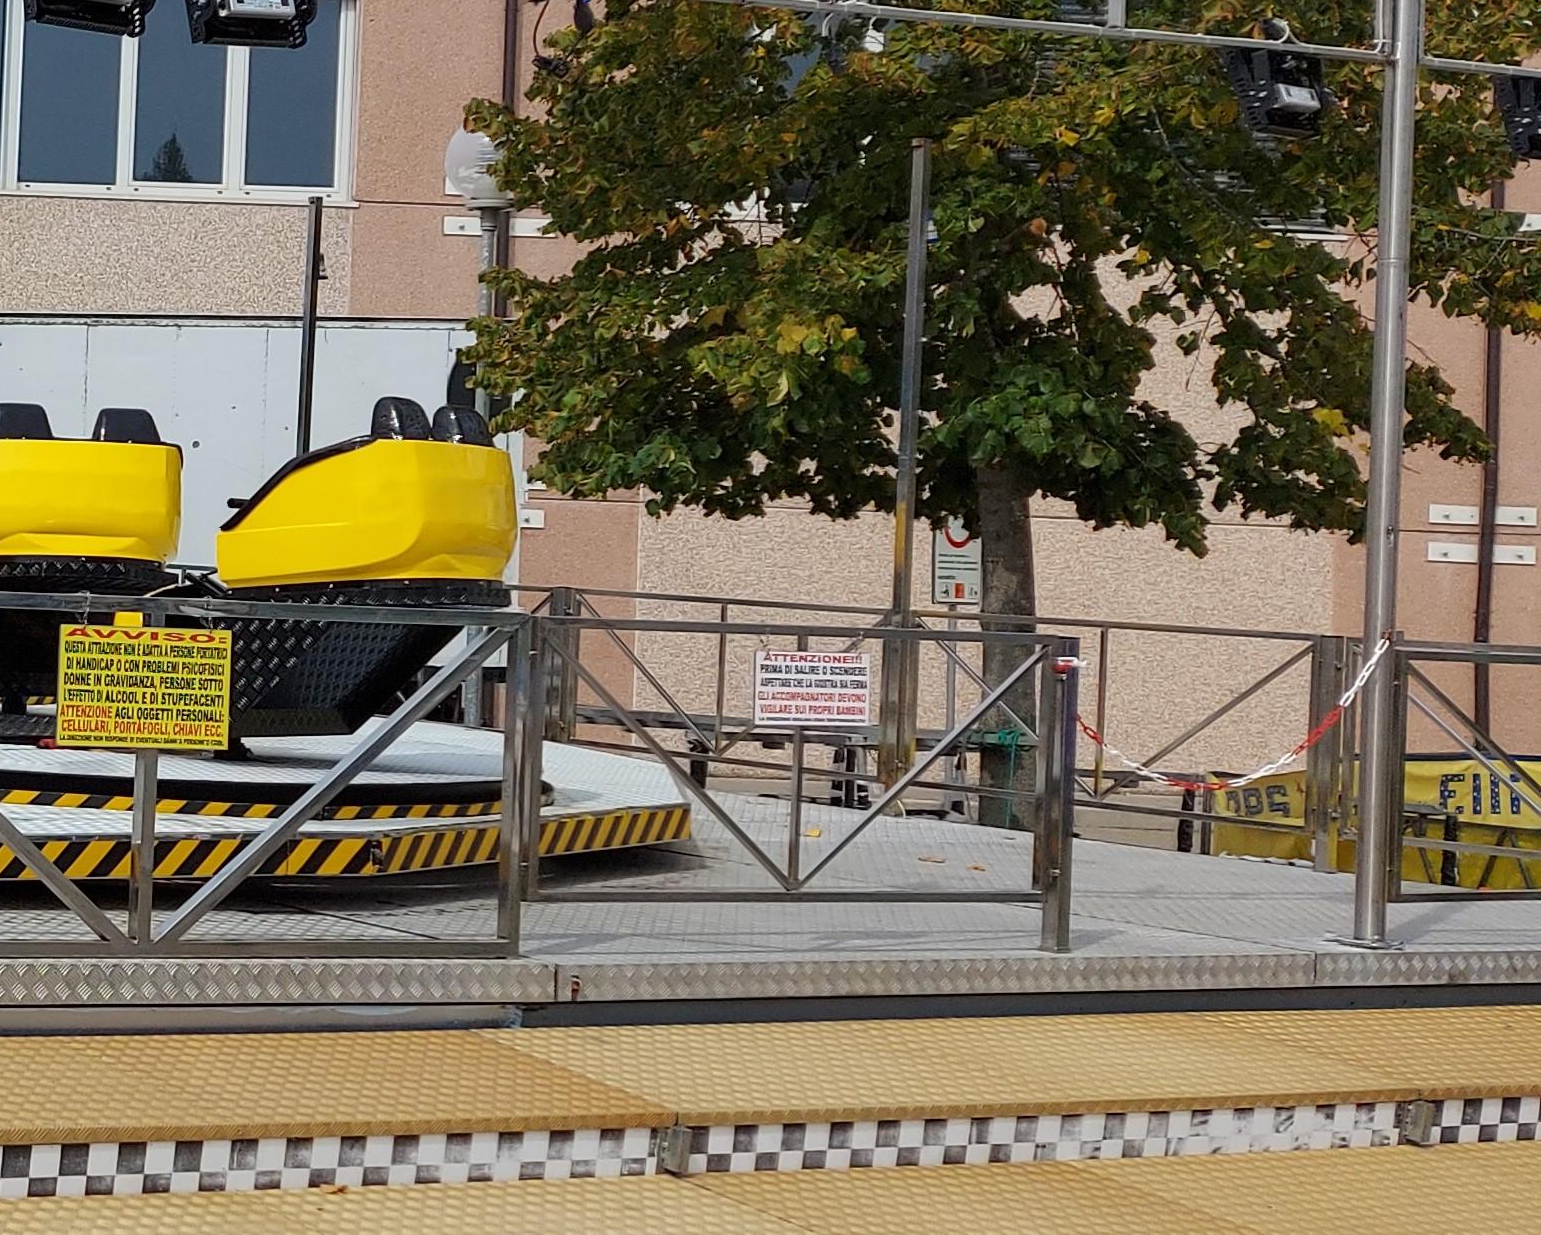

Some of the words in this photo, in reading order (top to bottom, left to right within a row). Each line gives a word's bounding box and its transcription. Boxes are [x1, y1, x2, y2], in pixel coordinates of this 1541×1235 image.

[64, 640, 86, 654] QUESTA
[87, 641, 122, 655] ATTRAZIONE
[170, 645, 195, 658] PERSONE
[66, 656, 74, 670] DI
[76, 657, 114, 671] HANDICAP
[117, 659, 122, 671] O
[124, 659, 140, 672] CON
[142, 660, 179, 674] PROBLEMI
[182, 662, 224, 676] PSICOFISICI
[760, 664, 783, 674] PRIMA
[784, 665, 792, 674] DI
[794, 665, 820, 675] SALIRE
[63, 672, 91, 685] DONNE
[93, 673, 102, 686] IN
[159, 676, 196, 690] PERSONE
[198, 678, 224, 691] SOTTO
[105, 689, 139, 704] ALCOOL
[142, 692, 147, 704] E
[150, 692, 158, 705] DI
[161, 692, 224, 707] STUPEFACENTI
[758, 691, 769, 700] GLI
[771, 692, 836, 702] ACCOMPAGNATORI
[838, 693, 866, 703] DEVONO
[60, 704, 112, 718] ATTENZIONE
[115, 706, 134, 720] AGLI
[137, 707, 173, 721] OGGETTI
[795, 705, 806, 714] SUI
[808, 705, 834, 715] PROPRI
[61, 719, 111, 735] CELLULARI,
[114, 720, 171, 737] PORTAFOGLI,
[173, 723, 202, 736] CHIAVI
[204, 724, 224, 737] ECC.
